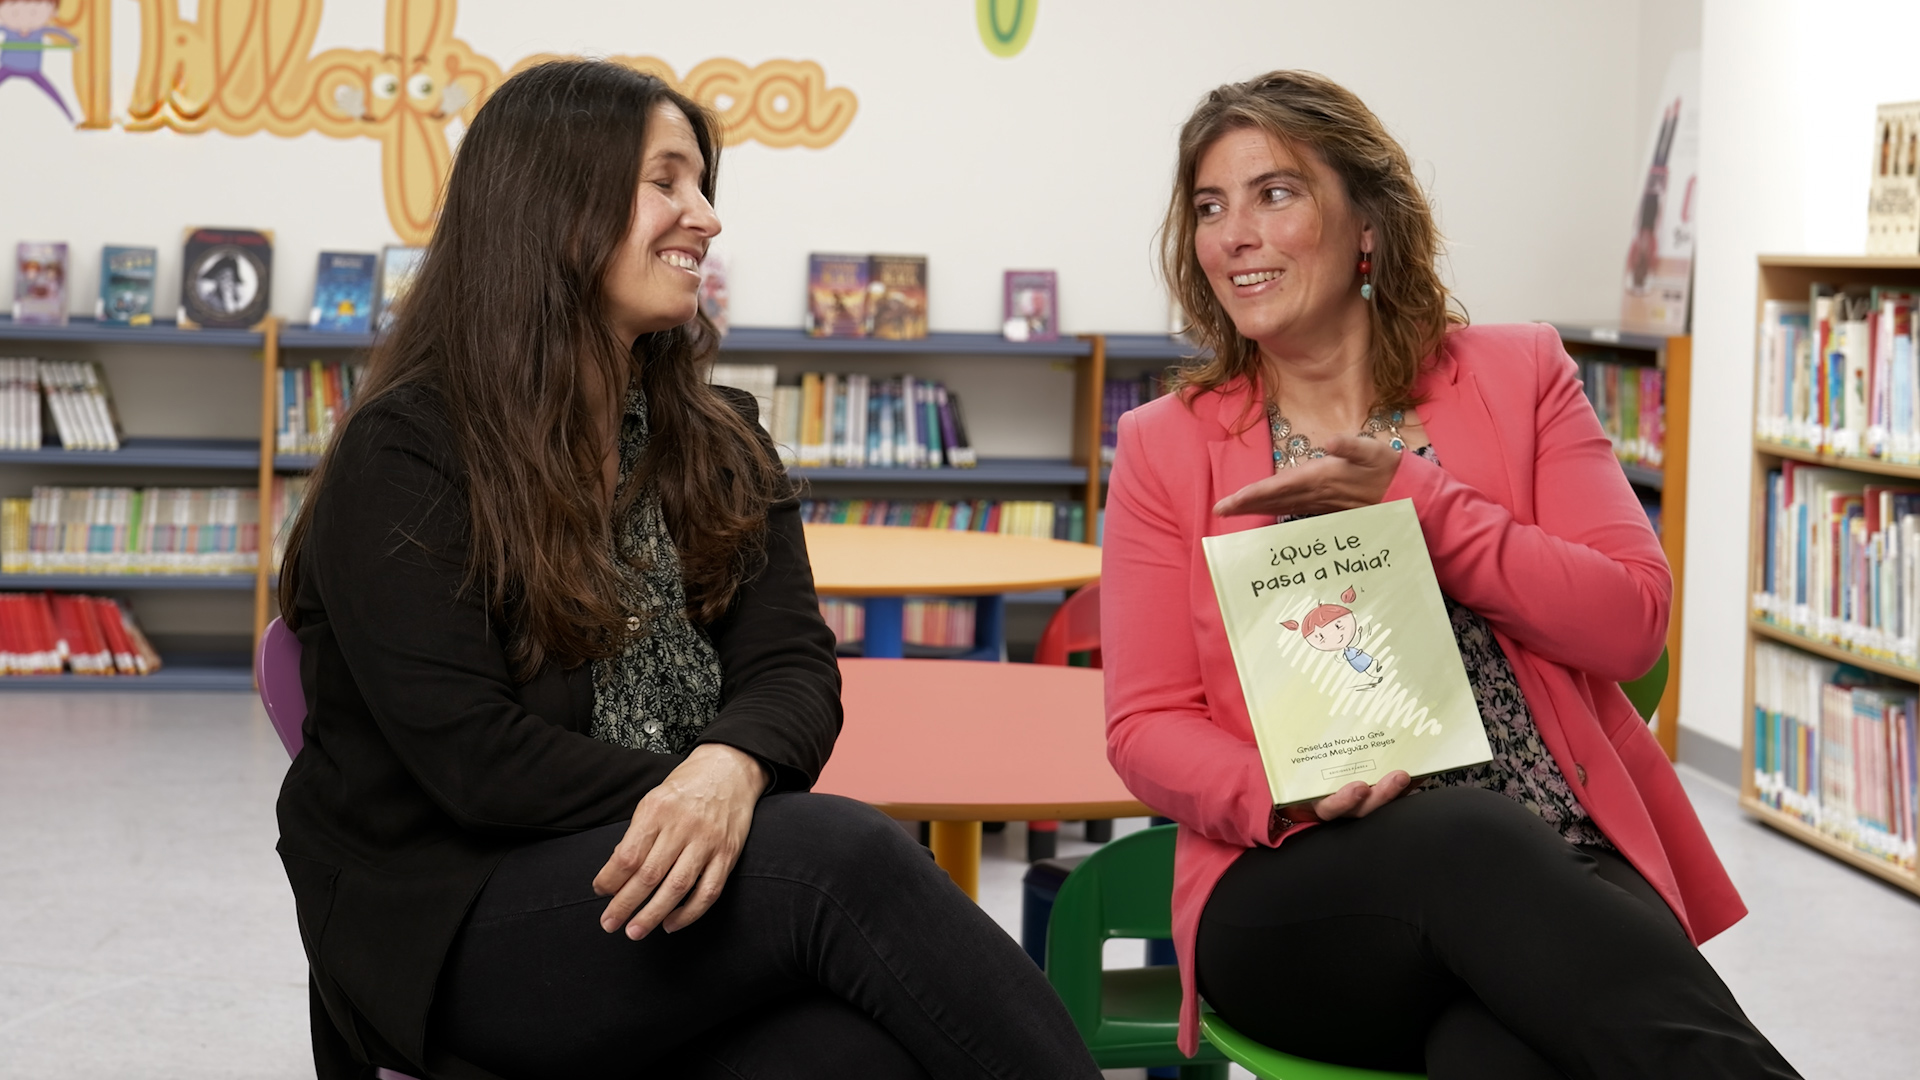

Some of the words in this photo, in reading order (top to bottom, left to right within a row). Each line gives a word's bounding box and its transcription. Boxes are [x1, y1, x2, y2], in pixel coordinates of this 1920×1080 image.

[1270, 538, 1327, 566] ¿Qué
[1251, 571, 1306, 597] pasa
[1314, 567, 1328, 581] a
[1333, 549, 1391, 576] Naia?
[1291, 752, 1328, 764] Verónica
[1329, 743, 1369, 757] Melguizo
[1370, 737, 1396, 749] Reyes
[1296, 742, 1333, 754] Griselda
[1334, 735, 1365, 746] Novillo
[1367, 729, 1385, 740] Gris
